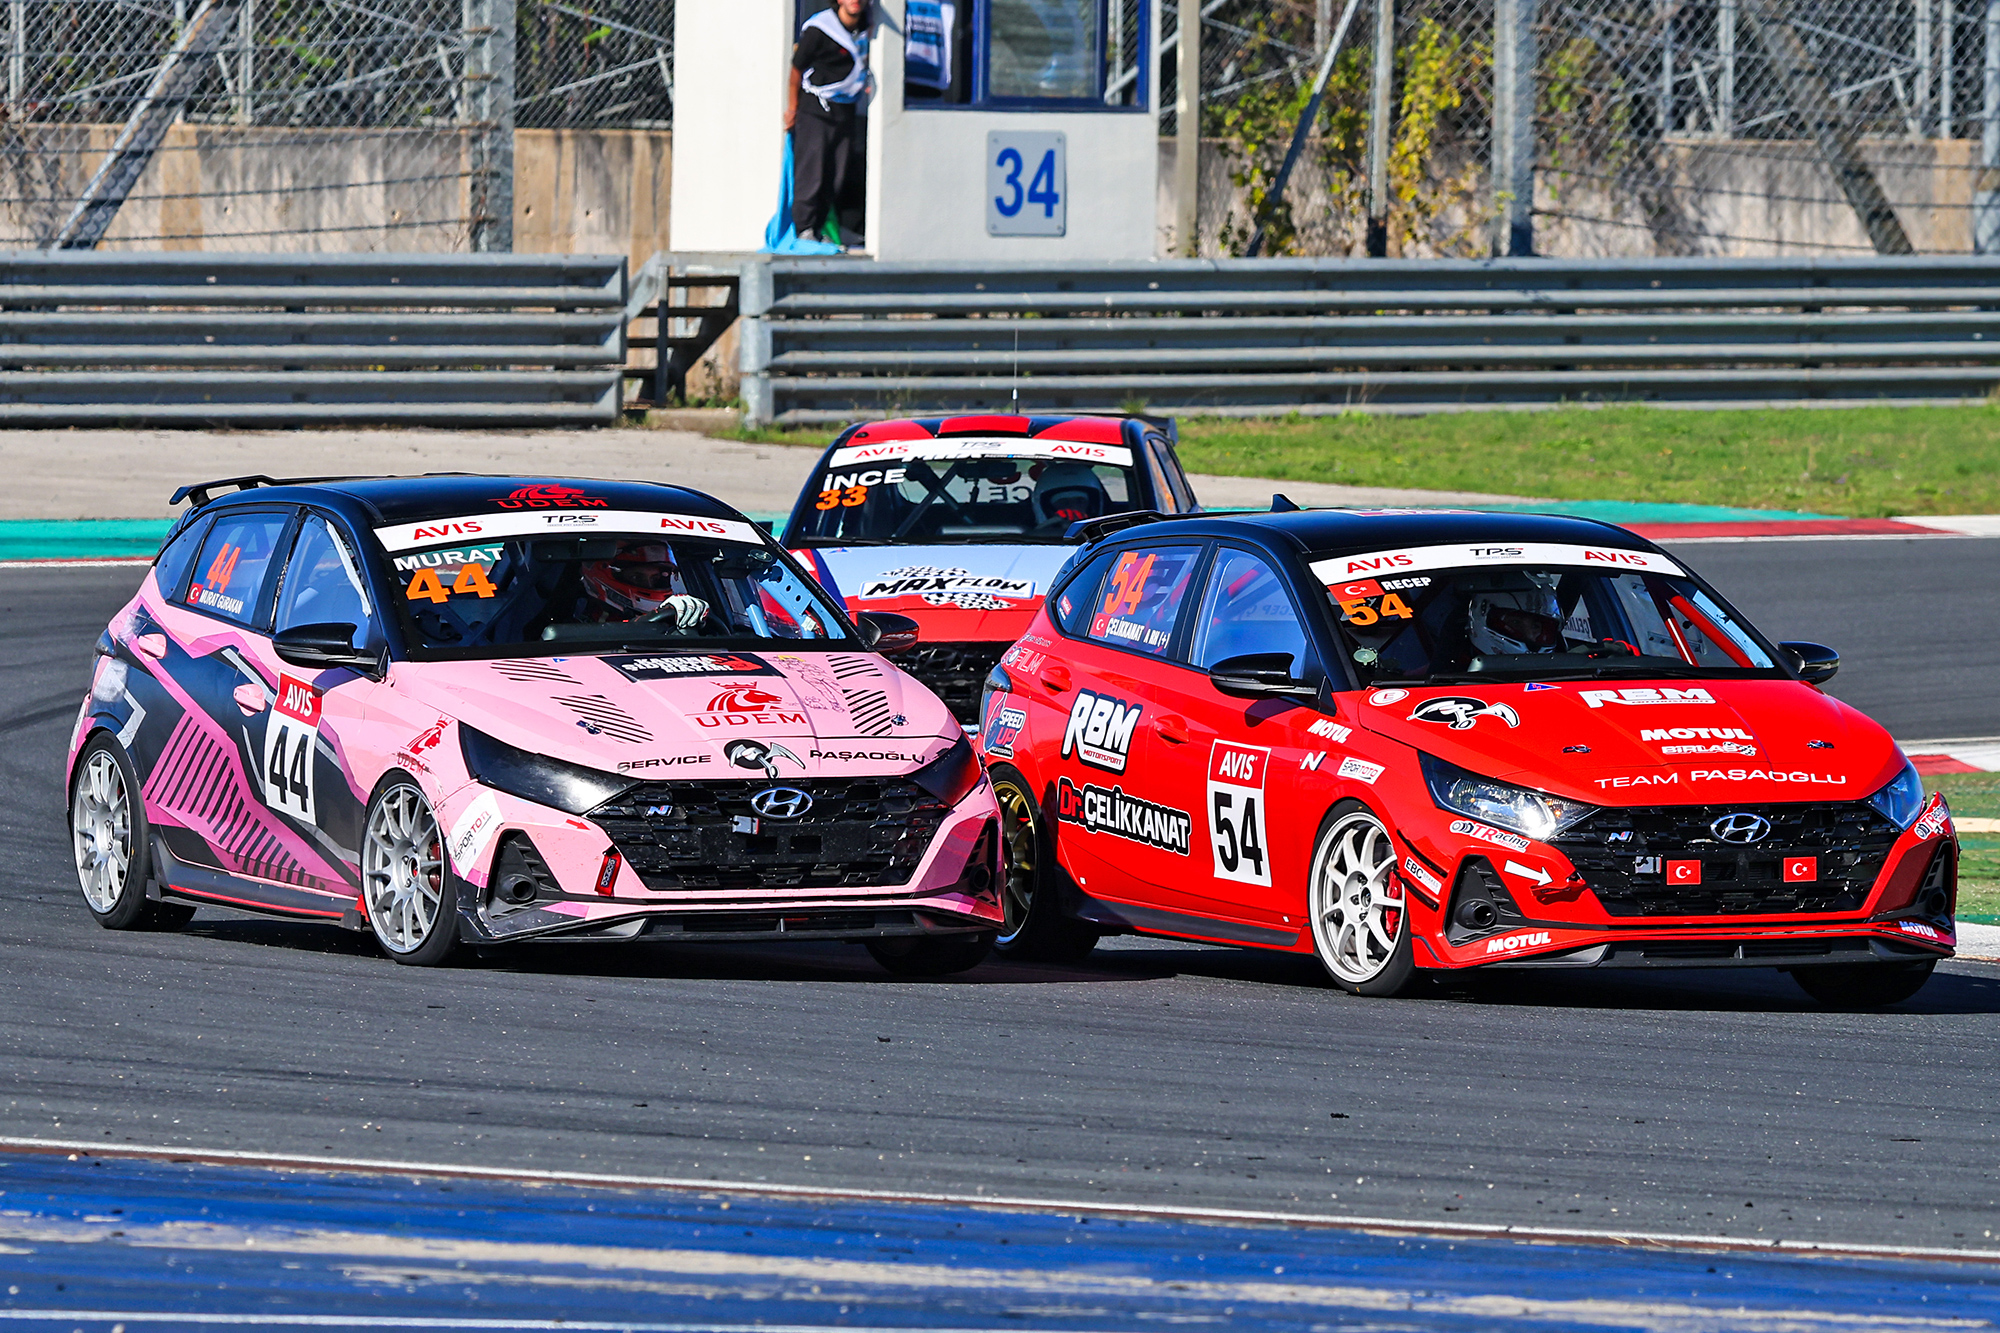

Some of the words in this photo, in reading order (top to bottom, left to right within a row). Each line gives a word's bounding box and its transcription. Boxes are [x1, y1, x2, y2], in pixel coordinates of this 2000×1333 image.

[994, 147, 1060, 219] 34
[855, 445, 908, 459] AVIS
[1051, 445, 1106, 458] AVIS
[497, 499, 609, 509] UDEM
[815, 485, 868, 511] 33
[542, 515, 599, 524] TPS
[660, 518, 727, 535] AVIS
[413, 521, 484, 540] AVIS
[393, 547, 504, 572] MURAT
[1469, 548, 1524, 556] TPS
[1584, 550, 1647, 566] AVIS
[206, 543, 242, 594] 44
[1347, 554, 1414, 574] AVIS
[405, 563, 498, 604] 44
[1104, 552, 1157, 615] 54
[1381, 577, 1431, 591] RECEP
[1339, 593, 1414, 626] 54
[282, 687, 314, 717] AVIS
[1578, 688, 1716, 708] RBM
[695, 712, 807, 728] UDEM
[998, 710, 1025, 729] SPEED
[1062, 693, 1141, 757] RBM
[994, 727, 1018, 746] UP
[1307, 718, 1353, 743] MOTUL
[1640, 728, 1753, 741] MOTUL
[616, 754, 711, 773] SERVICE
[1083, 749, 1124, 766] MOTORSPORT
[1219, 751, 1254, 780] AVIS
[269, 725, 310, 813] 44
[1594, 773, 1679, 789] TEAM
[1214, 790, 1263, 876] 54
[1405, 858, 1424, 879] EBC
[1899, 921, 1938, 938] MOTUL
[1486, 932, 1551, 953] MOTUL
